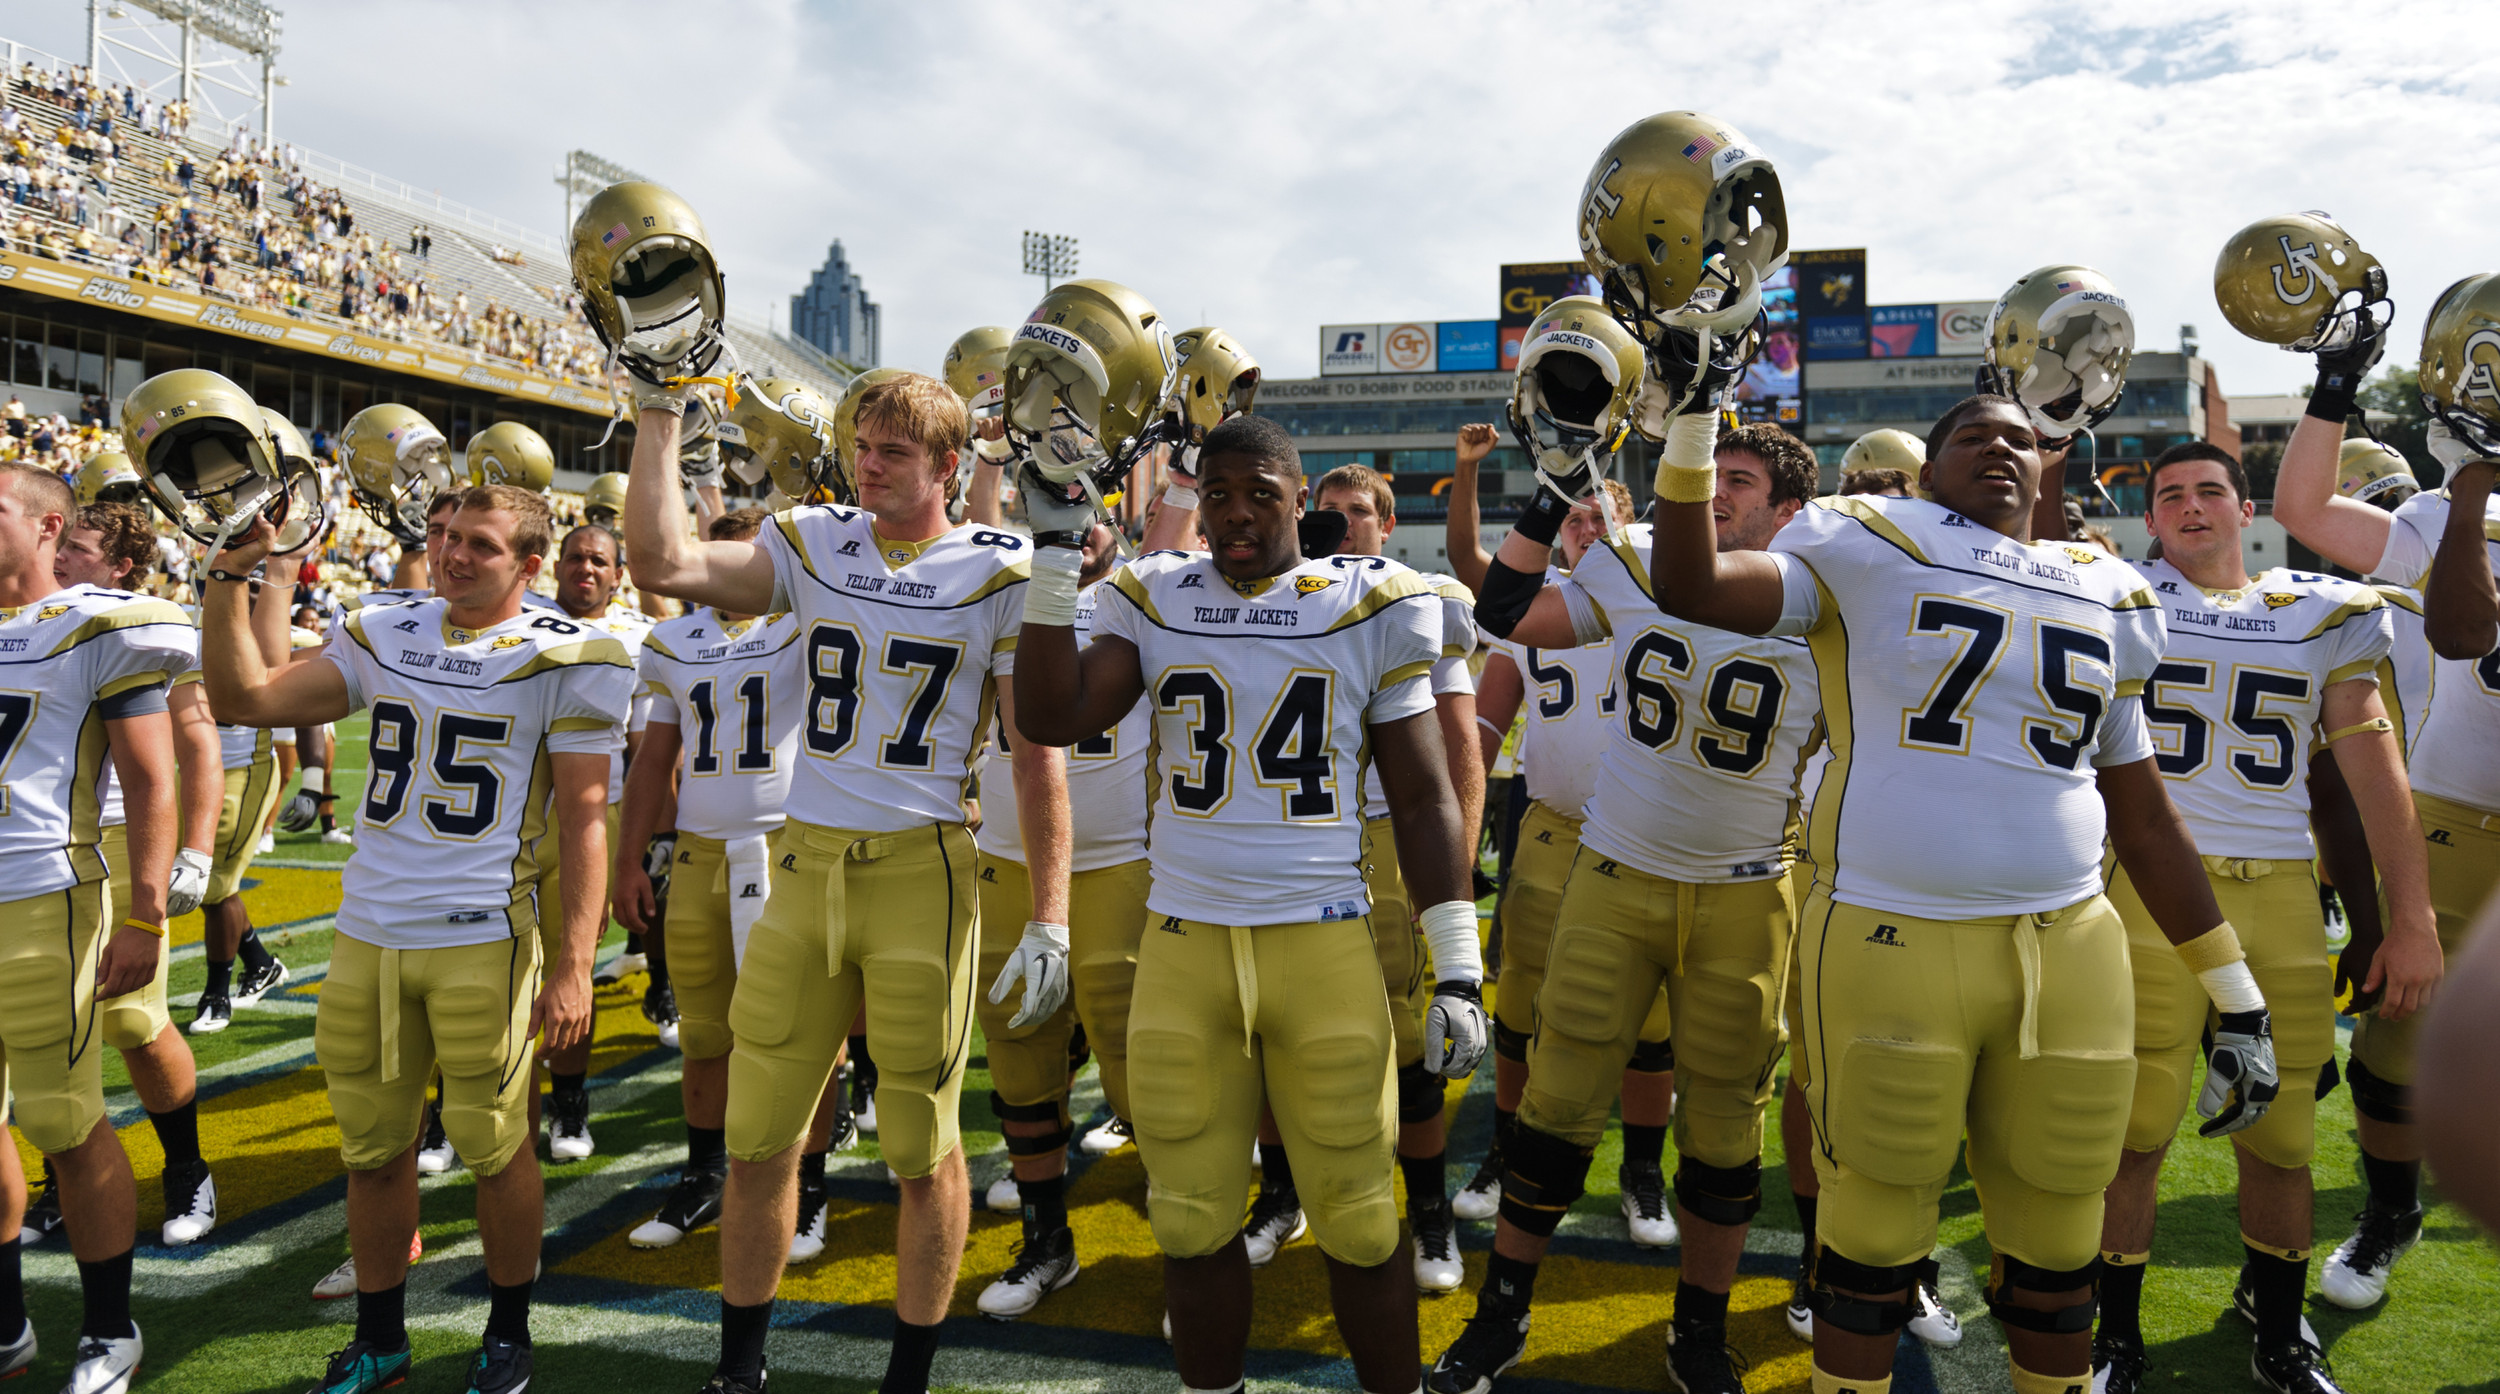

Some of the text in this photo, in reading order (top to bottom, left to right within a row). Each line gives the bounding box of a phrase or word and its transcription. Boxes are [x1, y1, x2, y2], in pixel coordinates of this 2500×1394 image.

[1724, 149, 1746, 164] JACK
[643, 216, 656, 228] 87
[80, 283, 145, 309] PUND
[1691, 288, 1717, 301] KETS
[2081, 292, 2127, 309] JACKETS
[1051, 312, 1067, 325] 34
[1886, 308, 1935, 321] DELTA
[1950, 313, 1985, 335] CS
[198, 311, 286, 340] FLOWERS
[1570, 321, 1583, 331] 69
[1020, 323, 1081, 354] JACKETS
[1392, 334, 1424, 354] GT
[1546, 332, 1595, 350] JACKETS
[1885, 364, 1974, 379] AT HISTOR
[1260, 377, 1514, 398] WELCOME TO BOBBY DODD STADIU
[170, 405, 186, 418] 85
[2363, 476, 2399, 496] JACKETS
[1971, 546, 2081, 586] YELLOW JACKETS
[844, 572, 938, 600] YELLOW JACKETS
[1299, 579, 1325, 588] ACC
[2266, 595, 2293, 603] ACC
[1193, 606, 1298, 627] YELLOW JACKETS
[2175, 608, 2276, 633] YELLOW JACKETS
[451, 629, 470, 643] GT
[399, 649, 483, 676] YELLOW JACKETS
[697, 645, 728, 660] YELLOW
[1899, 592, 2116, 773] 75
[802, 617, 967, 773] 87
[1621, 624, 1791, 779] 69
[686, 670, 777, 778] 11
[2144, 656, 2313, 793] 55
[1153, 664, 1342, 823] 34
[362, 693, 516, 843] 85
[1159, 925, 1188, 937] RUSSELL
[1865, 936, 1907, 947] RUSSELL
